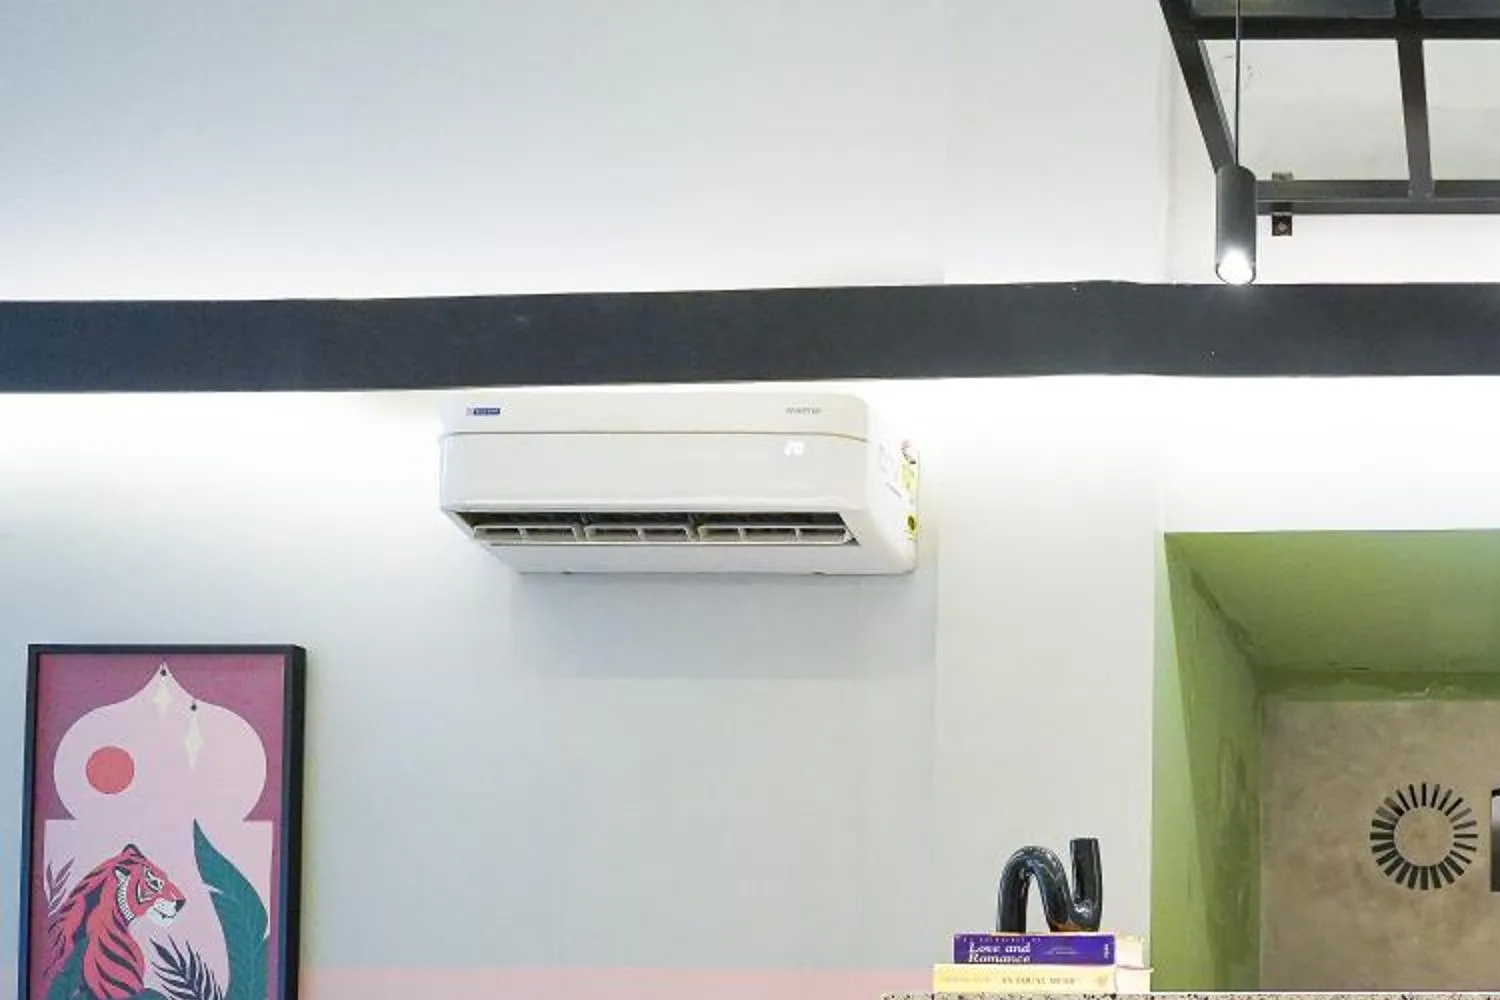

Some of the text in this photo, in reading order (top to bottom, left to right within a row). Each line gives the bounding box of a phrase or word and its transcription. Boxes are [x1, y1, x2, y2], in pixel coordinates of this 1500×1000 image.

[968, 941, 1031, 953] Love and
[968, 952, 1031, 963] Romance
